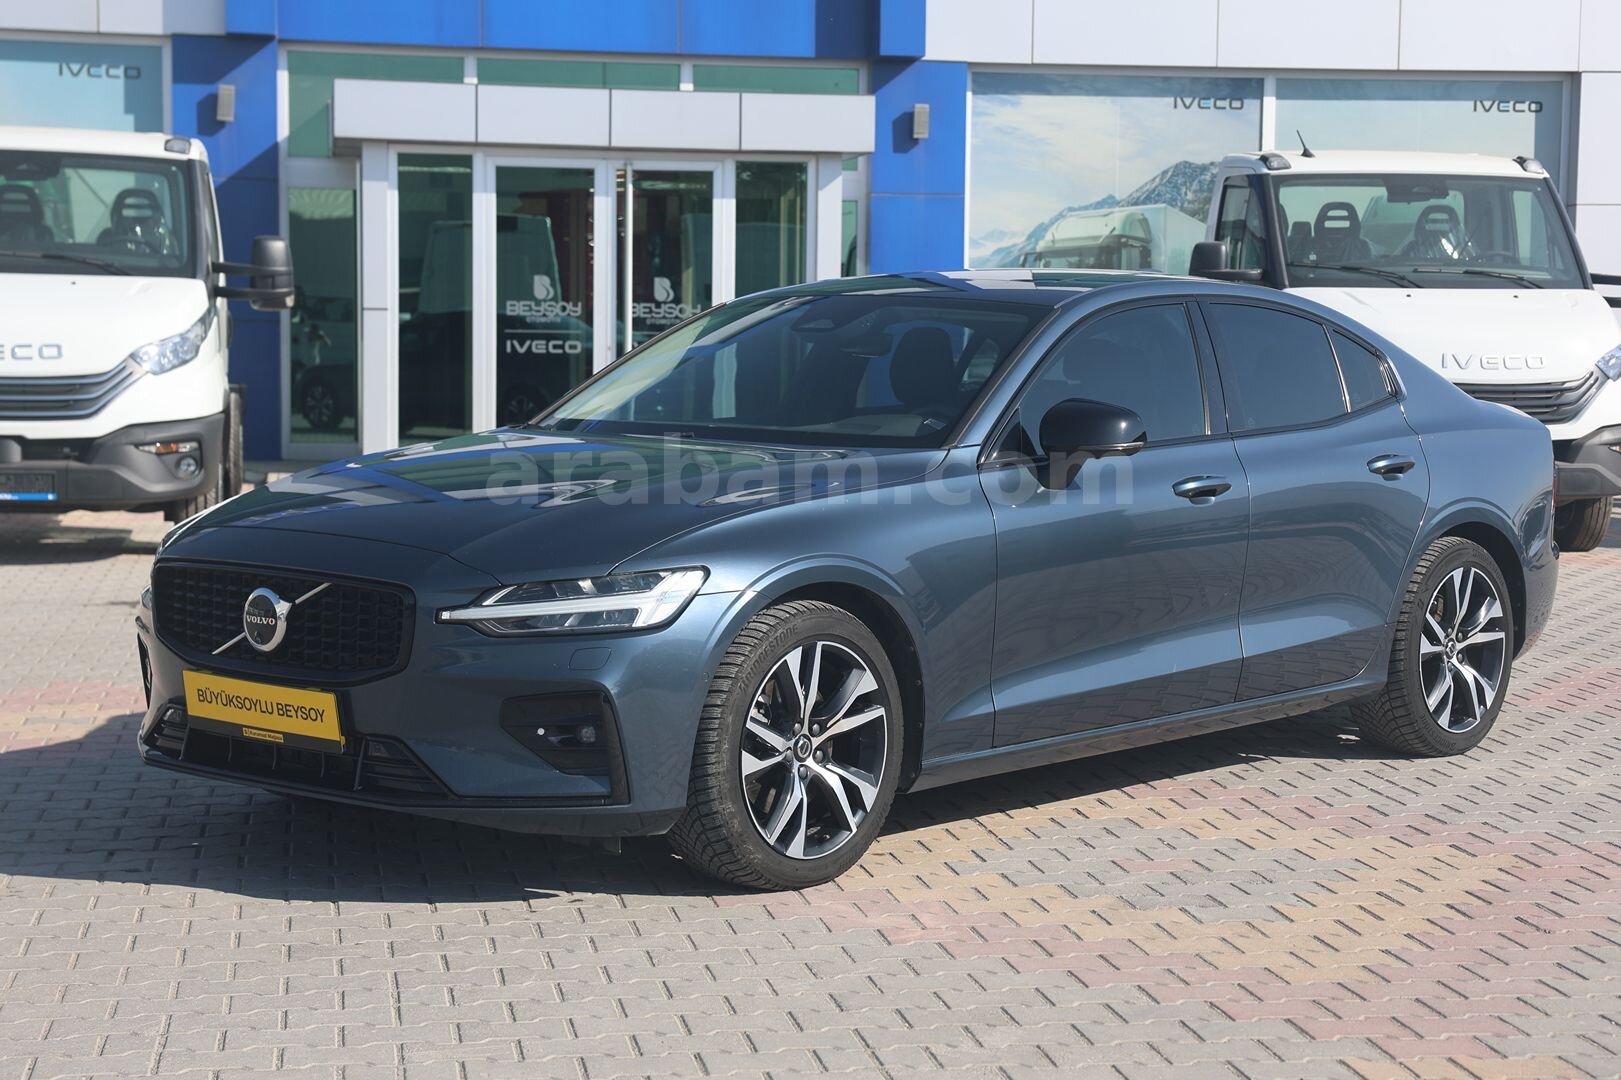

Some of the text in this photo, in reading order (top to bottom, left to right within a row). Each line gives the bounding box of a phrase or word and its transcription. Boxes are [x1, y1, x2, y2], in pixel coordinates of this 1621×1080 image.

[58, 62, 142, 80] IVECO
[1173, 96, 1244, 110] IVECO
[1473, 99, 1543, 113] IVECO
[506, 300, 582, 316] BEYSOY
[505, 340, 582, 354] IVECO
[1441, 352, 1547, 370] IVECO
[246, 615, 276, 626] VOLVO
[197, 687, 326, 723] BÜYÜKSOYLU BEYSOY
